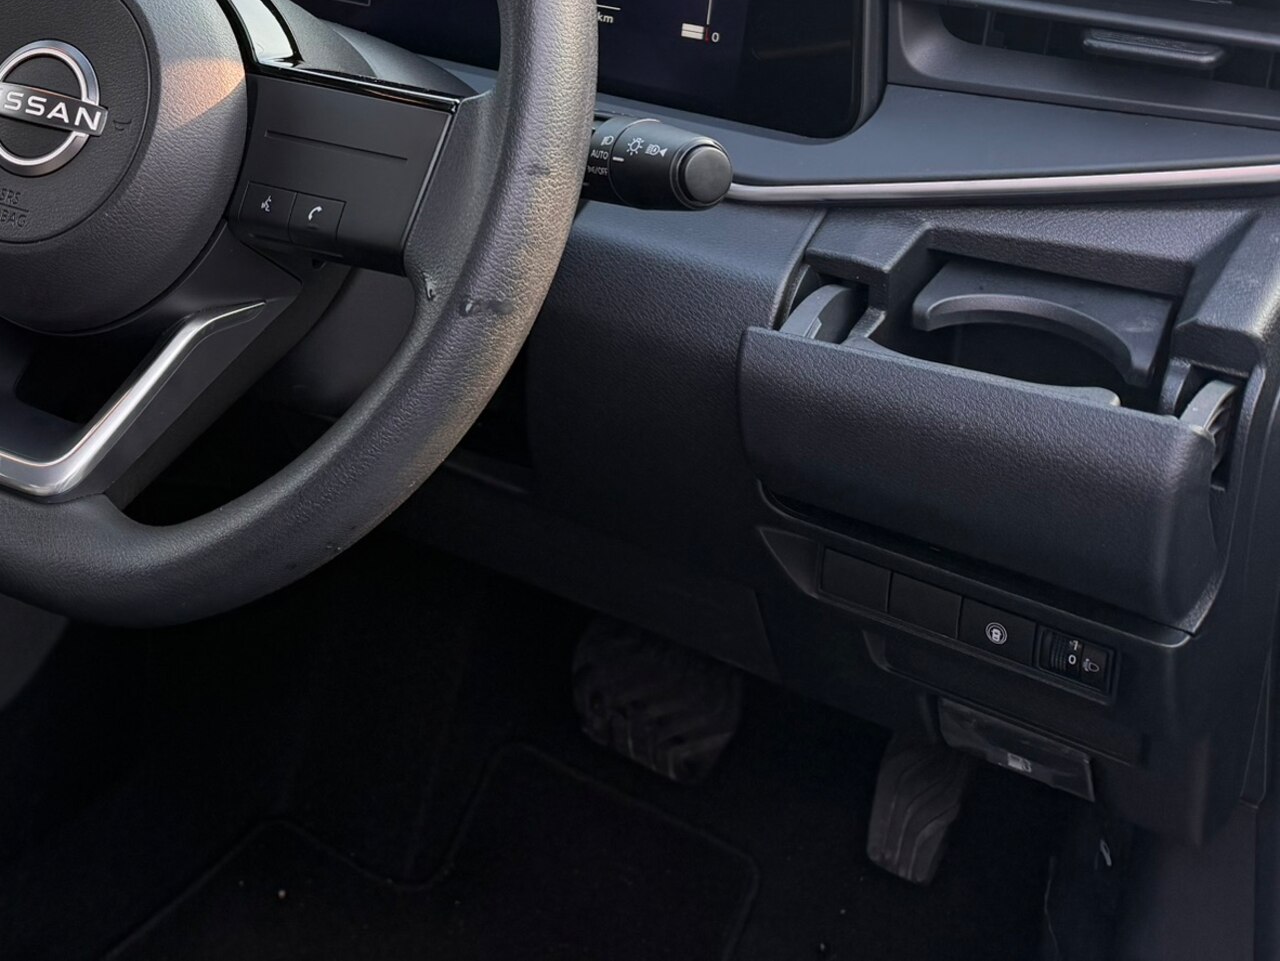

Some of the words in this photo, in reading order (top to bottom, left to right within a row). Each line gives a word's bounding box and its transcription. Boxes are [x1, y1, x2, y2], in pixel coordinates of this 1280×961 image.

[597, 11, 614, 24] km
[711, 32, 720, 43] 0
[590, 148, 609, 160] AUTO
[1068, 654, 1077, 665] 0
